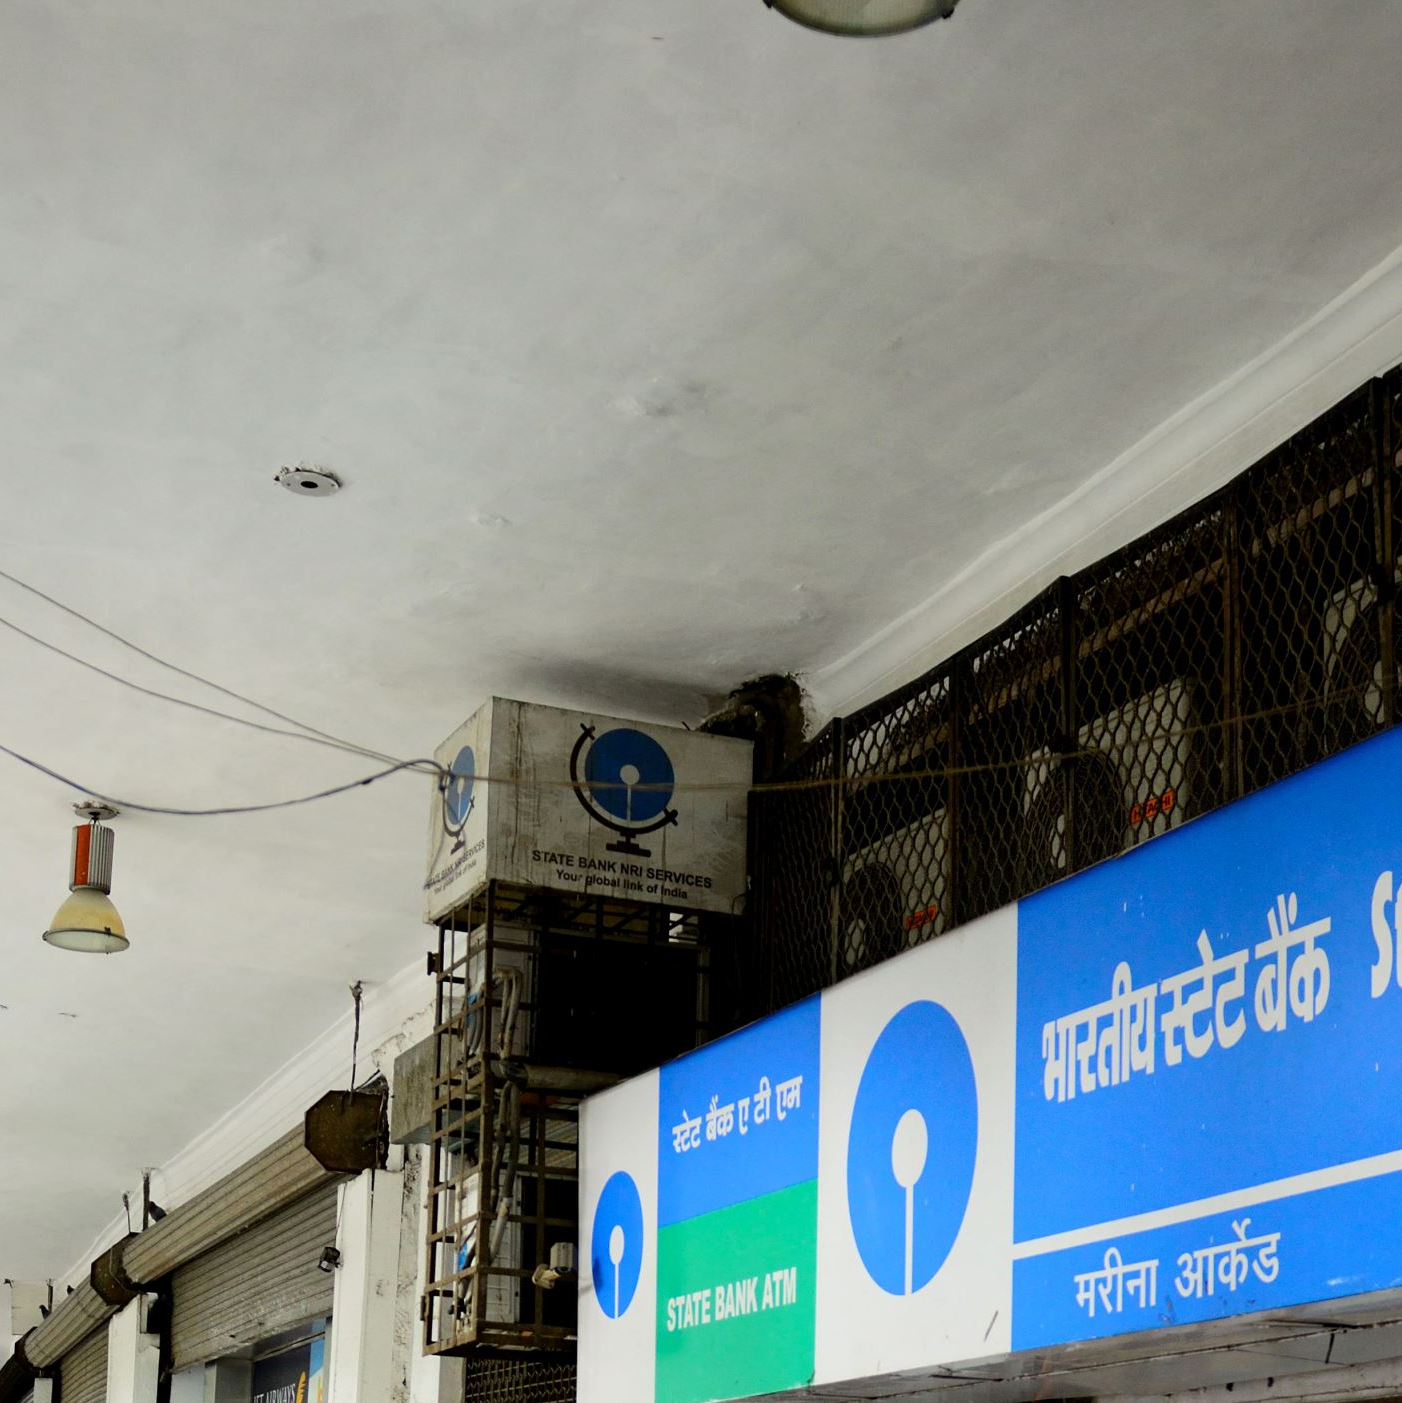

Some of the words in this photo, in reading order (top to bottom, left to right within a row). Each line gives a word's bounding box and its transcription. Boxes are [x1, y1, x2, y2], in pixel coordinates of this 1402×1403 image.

[533, 850, 574, 869] STATE
[578, 855, 616, 874] BANK
[619, 862, 642, 878] NRI
[646, 867, 713, 889] SERVICES
[556, 869, 582, 883] Your
[585, 873, 621, 890] global
[623, 878, 643, 893] link
[646, 883, 660, 895] of
[660, 885, 689, 900] India
[1042, 961, 1157, 1103] भारतीय
[1160, 929, 1249, 1066] स्टेट
[1255, 892, 1331, 1033] बैंक
[672, 1109, 702, 1154] स्टेट
[705, 1094, 735, 1142] बैंक
[737, 1097, 750, 1136] ए
[753, 1075, 771, 1124] टी
[775, 1075, 803, 1121] एम
[666, 1289, 711, 1333] STATE
[715, 1276, 758, 1322] BANK
[762, 1267, 797, 1311] ATM
[1074, 1247, 1159, 1317] मरीना
[1174, 1217, 1281, 1298] आर्केड
